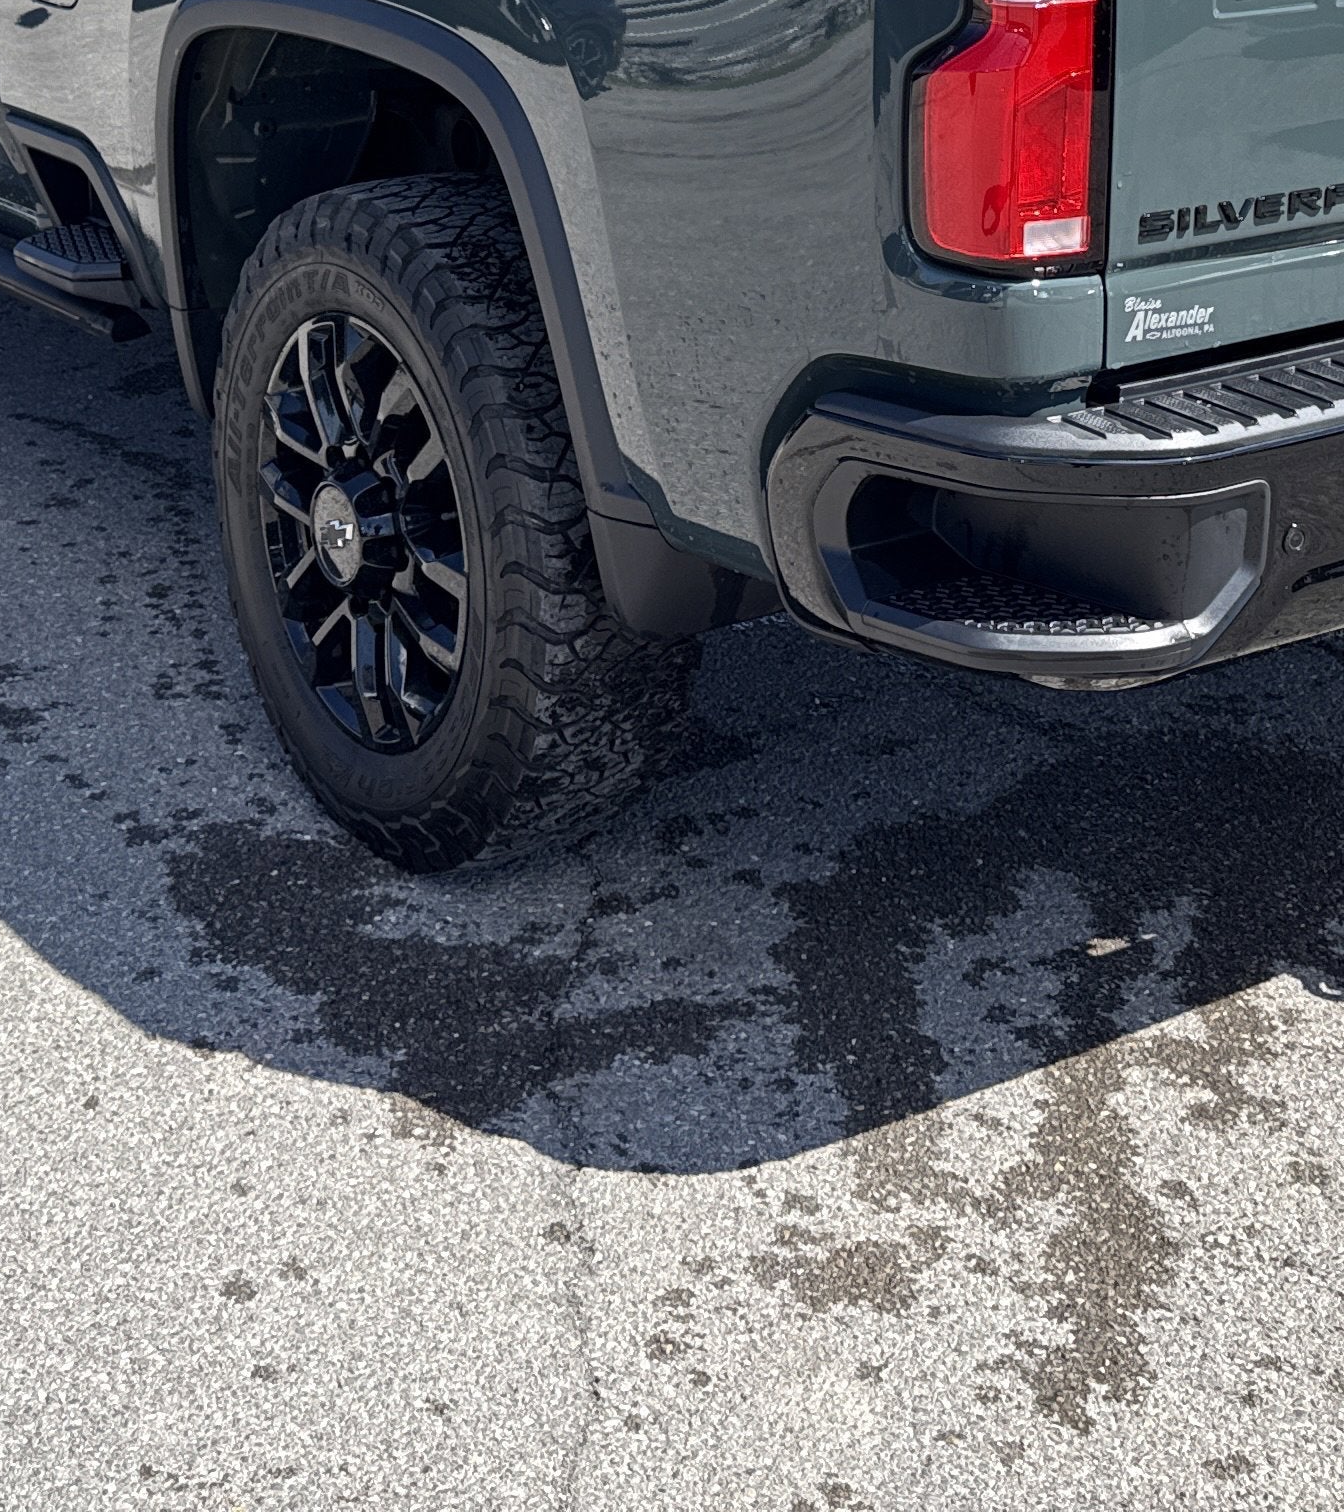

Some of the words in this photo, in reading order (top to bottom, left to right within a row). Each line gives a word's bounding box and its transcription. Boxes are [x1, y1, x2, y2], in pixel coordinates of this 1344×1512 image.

[1124, 296, 1162, 313] Blaise
[1124, 304, 1215, 343] Alexander
[1161, 325, 1202, 339] ALTOONA,
[1203, 323, 1215, 333] PA
